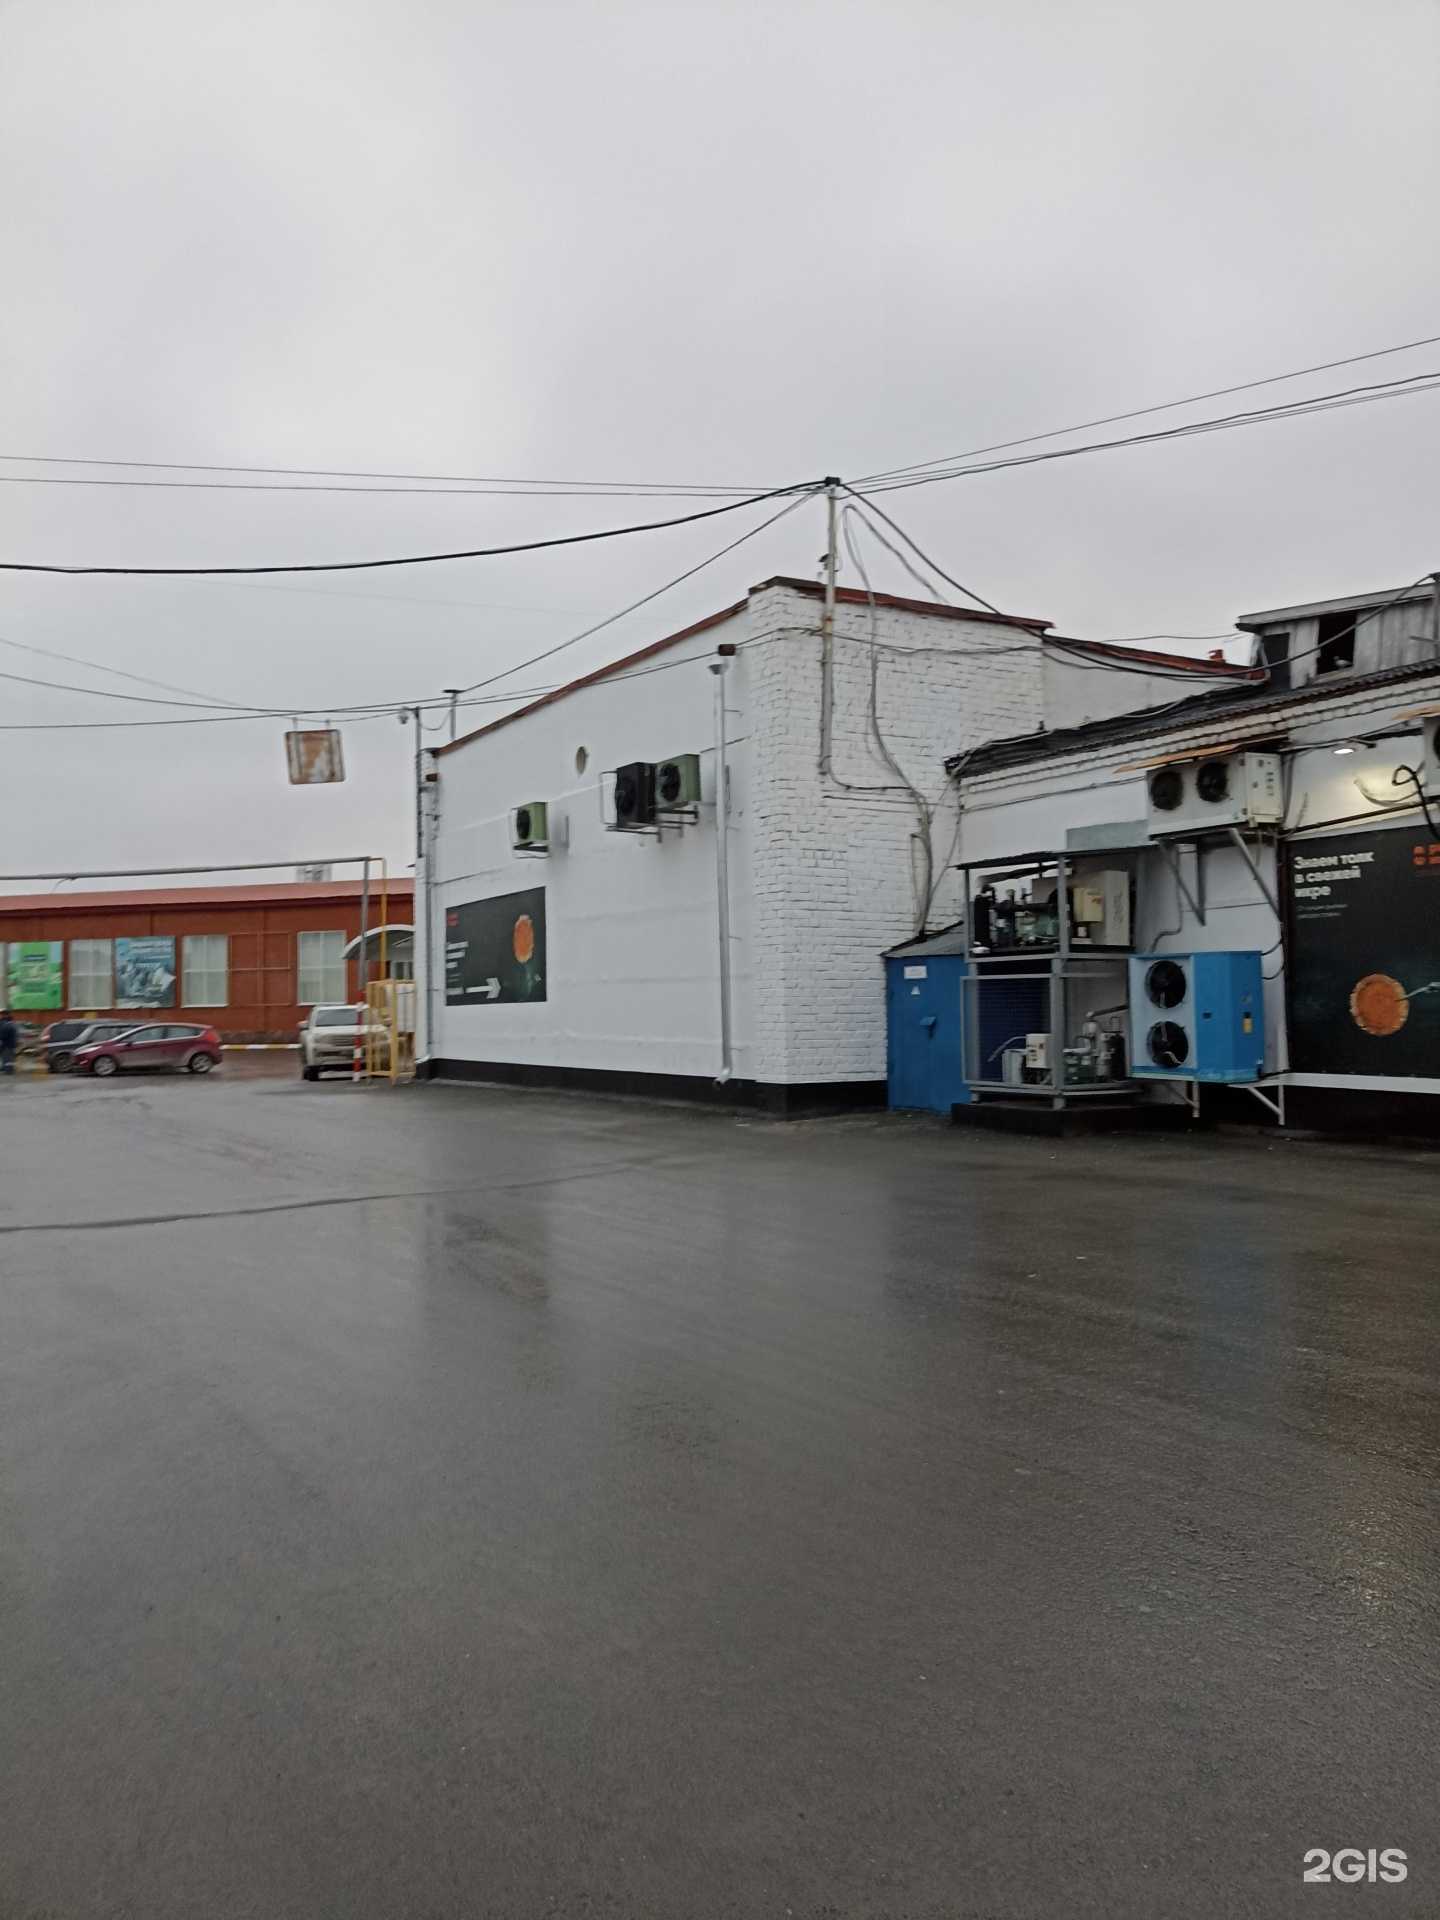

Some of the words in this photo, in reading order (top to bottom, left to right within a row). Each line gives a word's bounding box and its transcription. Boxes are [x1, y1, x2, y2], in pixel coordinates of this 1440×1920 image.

[1340, 852, 1375, 864] толк
[1294, 874, 1304, 883] в
[1306, 865, 1361, 882] свежей
[1294, 886, 1331, 900] икре
